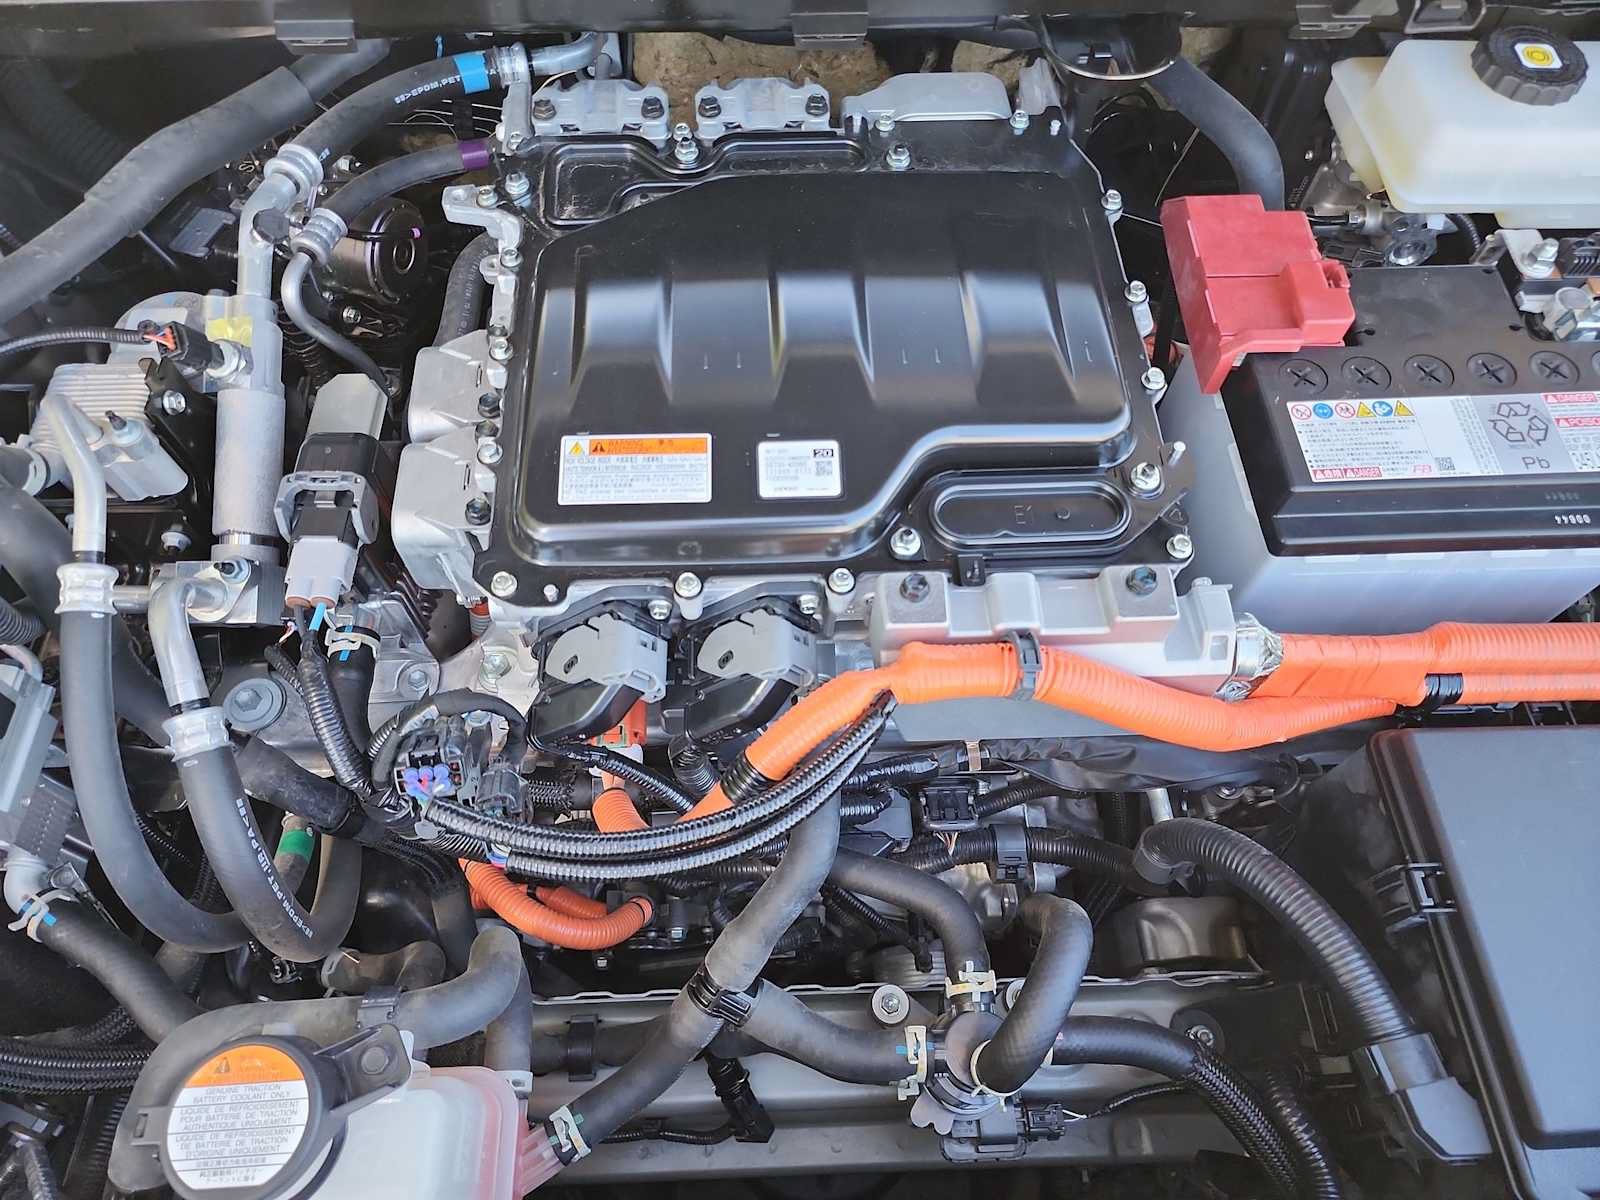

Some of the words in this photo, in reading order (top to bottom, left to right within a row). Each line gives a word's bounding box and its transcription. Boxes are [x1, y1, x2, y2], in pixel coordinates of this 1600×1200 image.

[1521, 456, 1550, 470] Pb
[1353, 467, 1382, 478] DANGER
[244, 1084, 281, 1094] TRACTION
[193, 1094, 226, 1104] BATTERY
[230, 1092, 266, 1102] COOLANT
[270, 1091, 290, 1100] ONLY
[180, 1115, 201, 1124] POUR
[205, 1113, 240, 1123] BATTERIE
[260, 1109, 298, 1119] TRACTION
[195, 1140, 232, 1150] BATTERIE
[251, 1135, 288, 1146] TRACTION
